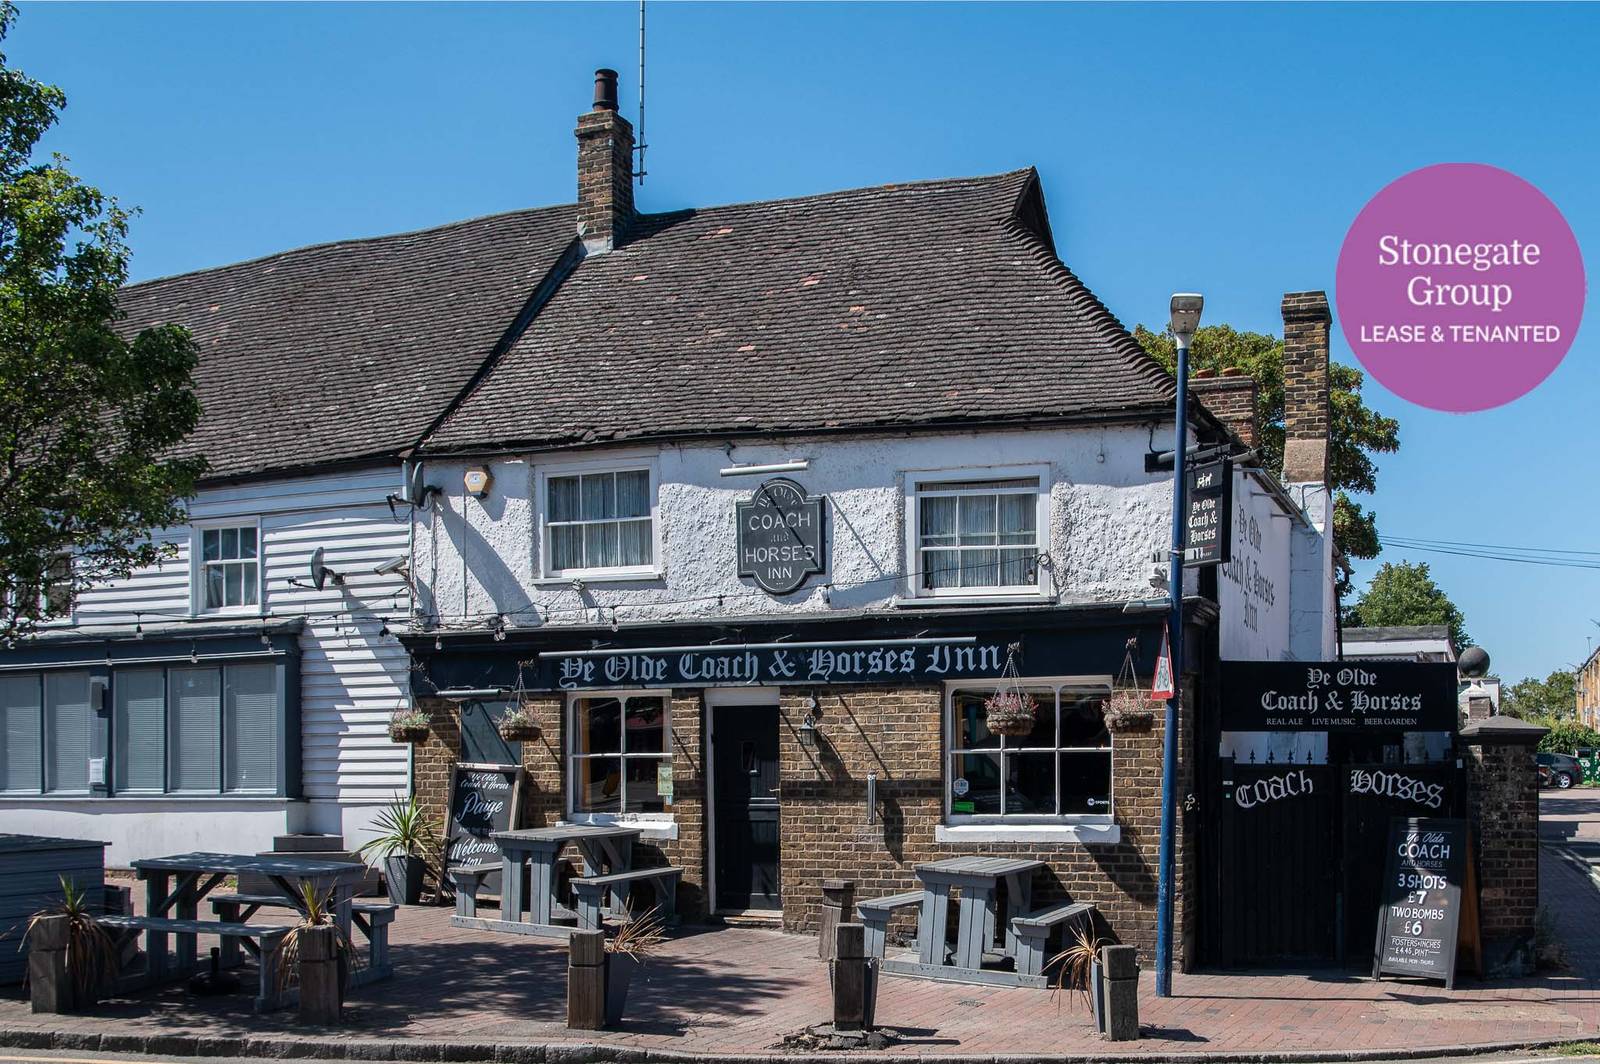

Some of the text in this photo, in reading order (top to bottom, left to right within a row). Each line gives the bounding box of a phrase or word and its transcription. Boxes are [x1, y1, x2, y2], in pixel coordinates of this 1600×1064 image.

[1191, 498, 1216, 514] Ye Olde
[748, 511, 811, 531] COACH
[1188, 510, 1218, 528] Coach &
[1190, 527, 1217, 545] Horses
[745, 545, 815, 563] HORSES
[768, 566, 792, 579] INN
[558, 645, 1001, 688] Ye Olde Coach & Horses Inn
[1306, 667, 1378, 689] Ye Olde
[1260, 690, 1422, 714] Coach & Horses
[1266, 717, 1417, 726] REAL ALE LIVE MUSIC BEER GARDEN
[1235, 769, 1444, 809] Coach Horses
[455, 791, 504, 823] Paige
[1406, 832, 1445, 845] Ye Olde
[451, 838, 498, 860] Welcome
[1398, 843, 1450, 859] COACH
[1401, 859, 1443, 868] AND HORSES
[1398, 873, 1447, 890] 3 SHOTS
[1408, 890, 1427, 905] £7
[1391, 906, 1444, 920] TWO BOMBS
[1404, 920, 1422, 936] £6
[1391, 937, 1418, 947] FOSTERS
